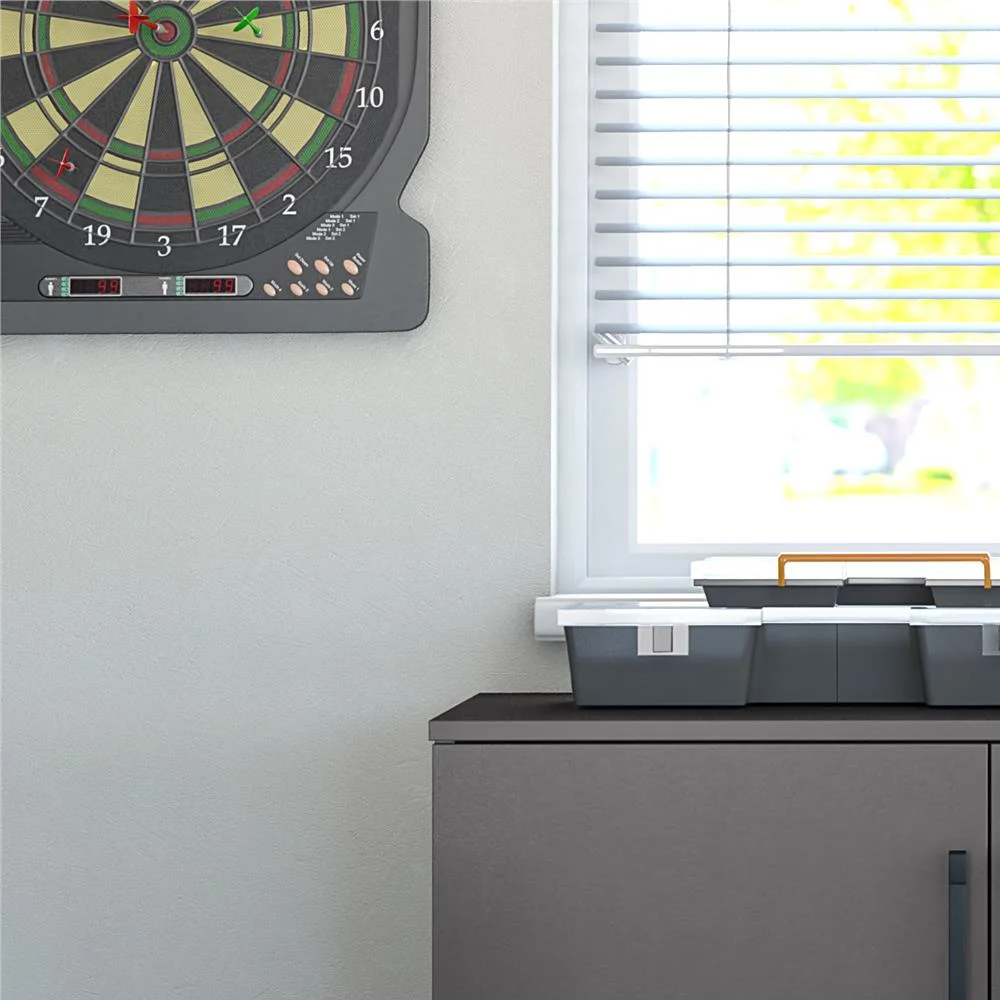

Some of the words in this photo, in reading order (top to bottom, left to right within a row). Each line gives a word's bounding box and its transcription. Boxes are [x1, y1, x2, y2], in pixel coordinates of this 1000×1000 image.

[370, 19, 384, 40] 6
[356, 86, 384, 108] 10
[324, 147, 352, 168] 15
[34, 196, 48, 218] 7
[282, 194, 297, 215] 2
[83, 224, 112, 246] 19
[218, 224, 246, 246] 17
[156, 236, 172, 257] 3
[98, 279, 118, 294] 99
[213, 278, 234, 294] 99
